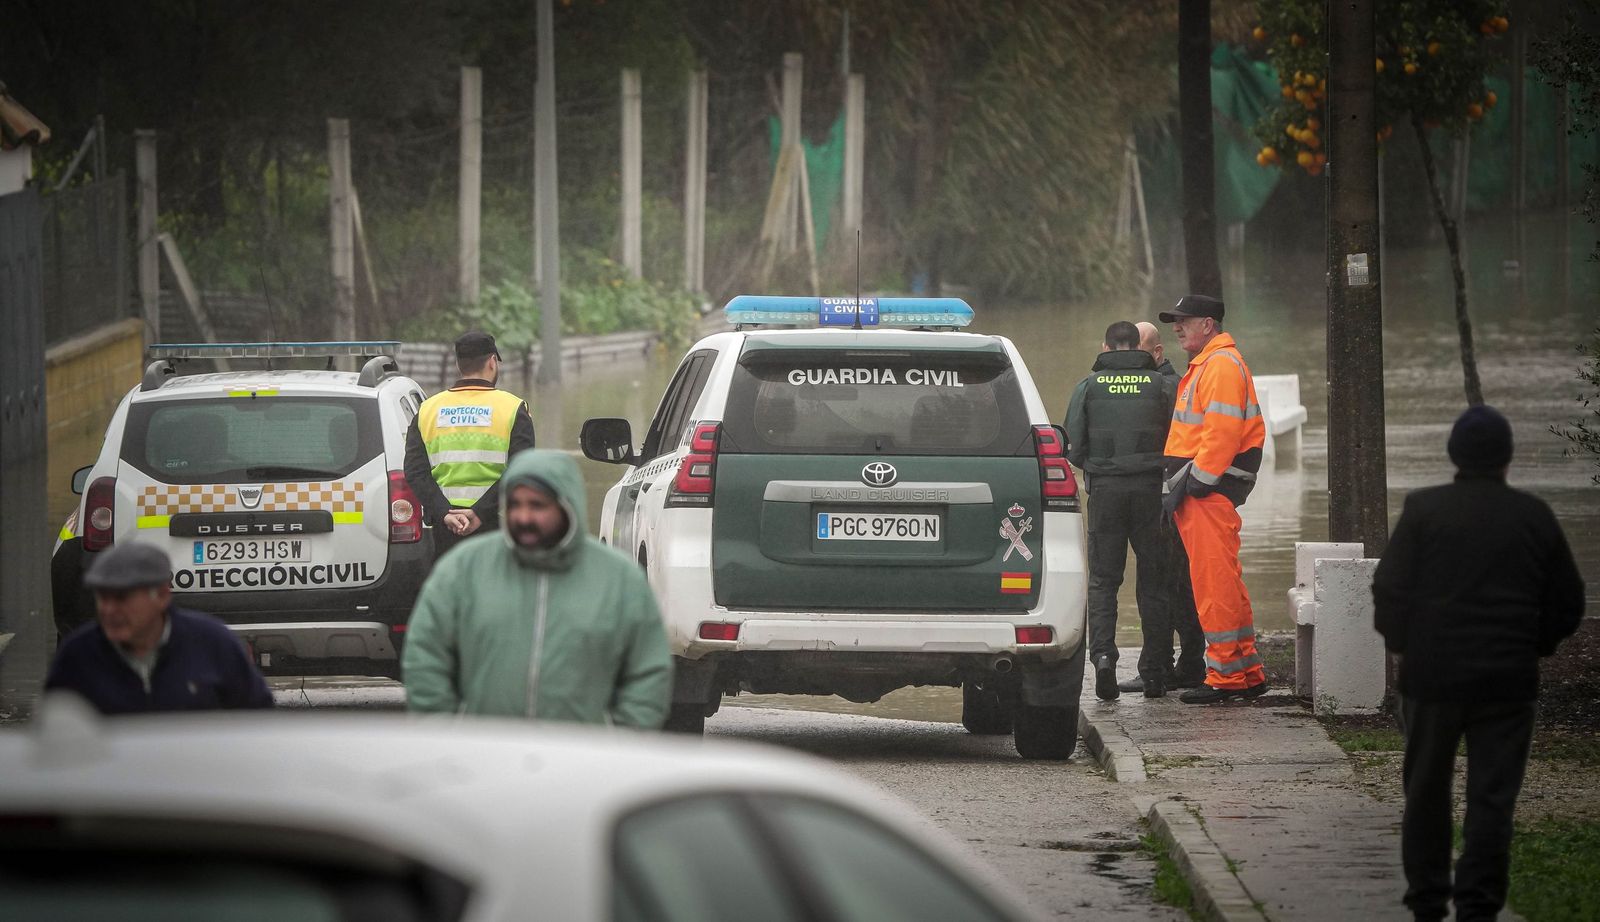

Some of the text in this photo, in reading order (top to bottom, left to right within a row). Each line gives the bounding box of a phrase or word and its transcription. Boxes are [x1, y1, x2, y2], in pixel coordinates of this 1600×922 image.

[834, 305, 865, 313] CIVIL
[787, 368, 964, 387] GUARDIA CIVIL
[1096, 375, 1151, 383] GUARDIA
[1108, 384, 1141, 393] CIVIL
[440, 407, 490, 415] PROTECCION
[450, 415, 477, 424] CIVIL
[812, 488, 949, 500] LAND CRUISER
[198, 523, 303, 534] DUSTER
[831, 517, 867, 536] PGC
[872, 518, 920, 537] 9760
[924, 518, 937, 537] N
[206, 542, 259, 561] 6293
[263, 540, 302, 560] HSW
